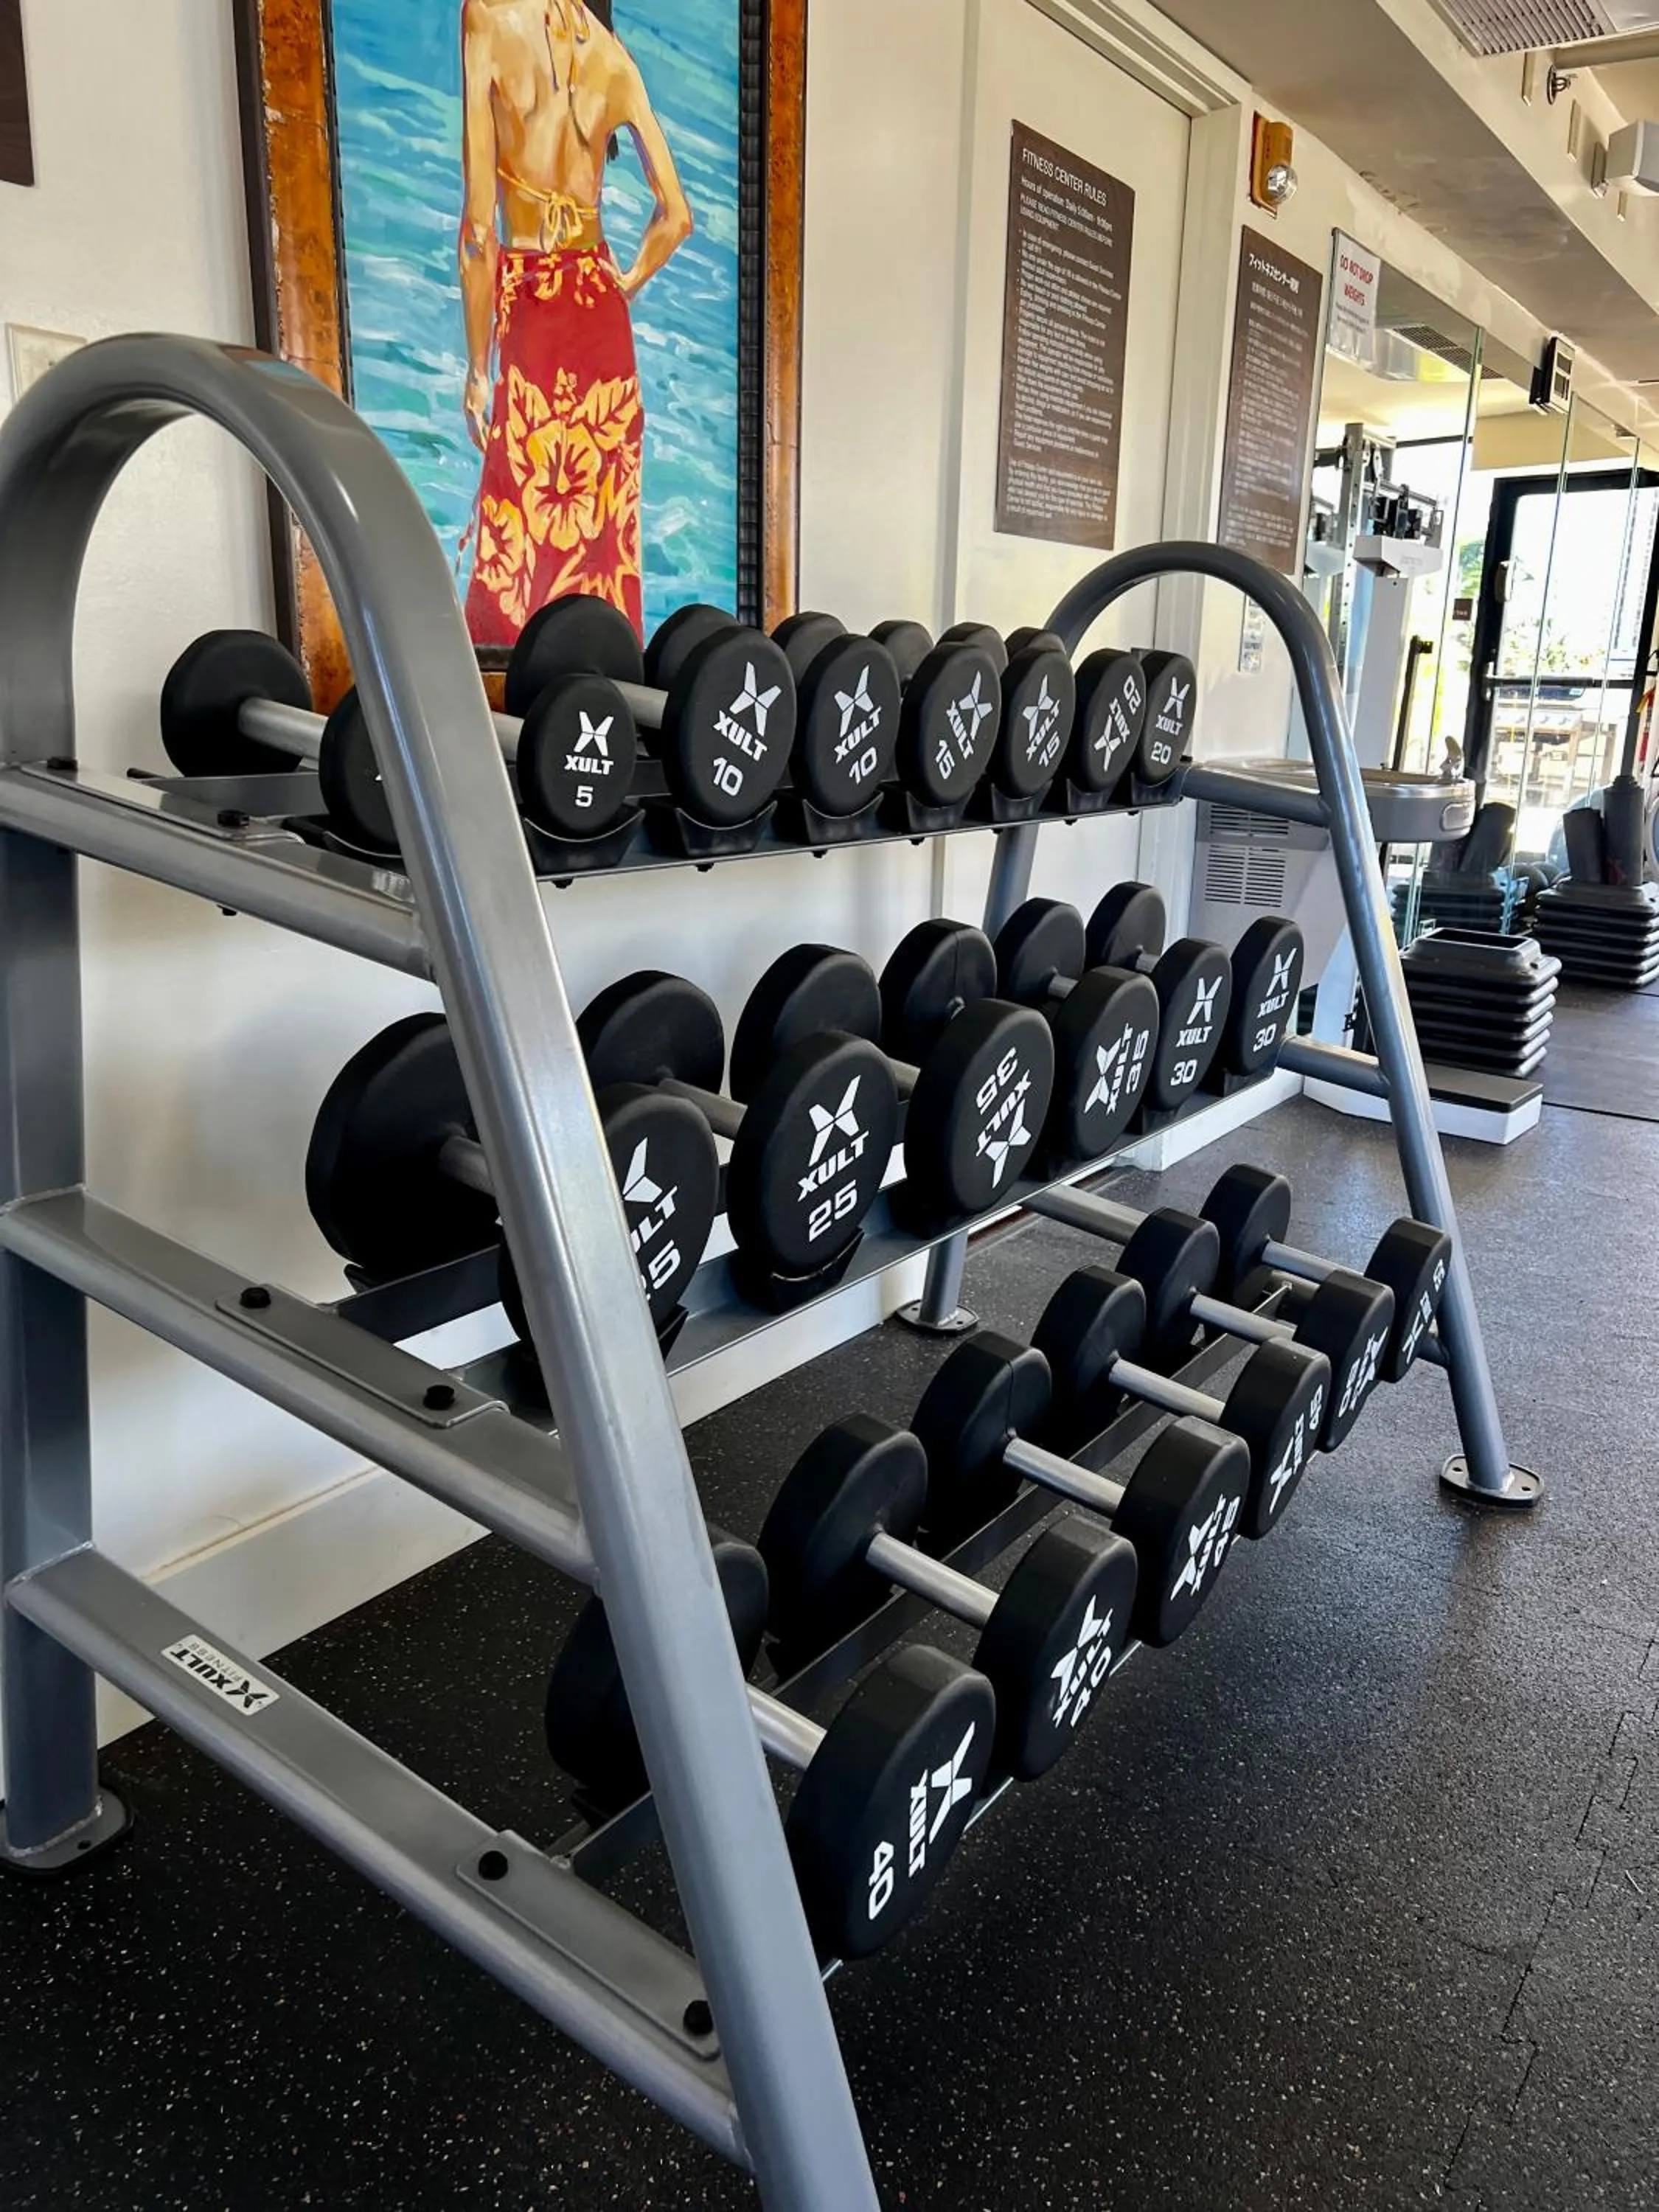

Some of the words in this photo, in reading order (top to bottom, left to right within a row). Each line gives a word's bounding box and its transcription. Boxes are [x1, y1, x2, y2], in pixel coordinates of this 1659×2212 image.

[1022, 147, 1053, 177] FITNESS
[1054, 166, 1083, 194] CENTER
[1084, 182, 1107, 207] RULES
[1109, 698, 1131, 744] XULT
[1123, 675, 1142, 714] 20
[712, 709, 768, 762] XULT
[833, 706, 883, 764] XULT
[946, 699, 975, 760] XULT
[1026, 698, 1060, 762] XULT
[1039, 731, 1060, 767] 15
[1155, 714, 1183, 736] XULT
[564, 754, 614, 776] XULT
[712, 757, 743, 797] 10
[848, 746, 877, 785] 10
[934, 740, 955, 780] 15
[1150, 741, 1172, 765] 20
[574, 786, 594, 808] 5
[1256, 988, 1290, 1018] XULT
[1125, 1029, 1150, 1095] 35
[1176, 1026, 1213, 1048] XULT
[1253, 1023, 1277, 1053] 30
[975, 1047, 1019, 1116] 35
[1105, 1022, 1134, 1115] XULT
[1169, 1059, 1198, 1087] 30
[975, 1068, 1032, 1157] XULT
[797, 1130, 869, 1203] XULT
[808, 1179, 858, 1243] 25
[1190, 1493, 1227, 1597] XULT
[1214, 1495, 1241, 1568] 45
[169, 1649, 232, 1690] XULT
[187, 1641, 243, 1681] FITNESS
[1052, 1607, 1113, 1728] XULT
[1070, 1646, 1112, 1728] 40
[908, 1769, 928, 1879] XULT
[869, 1840, 894, 1921] 40
